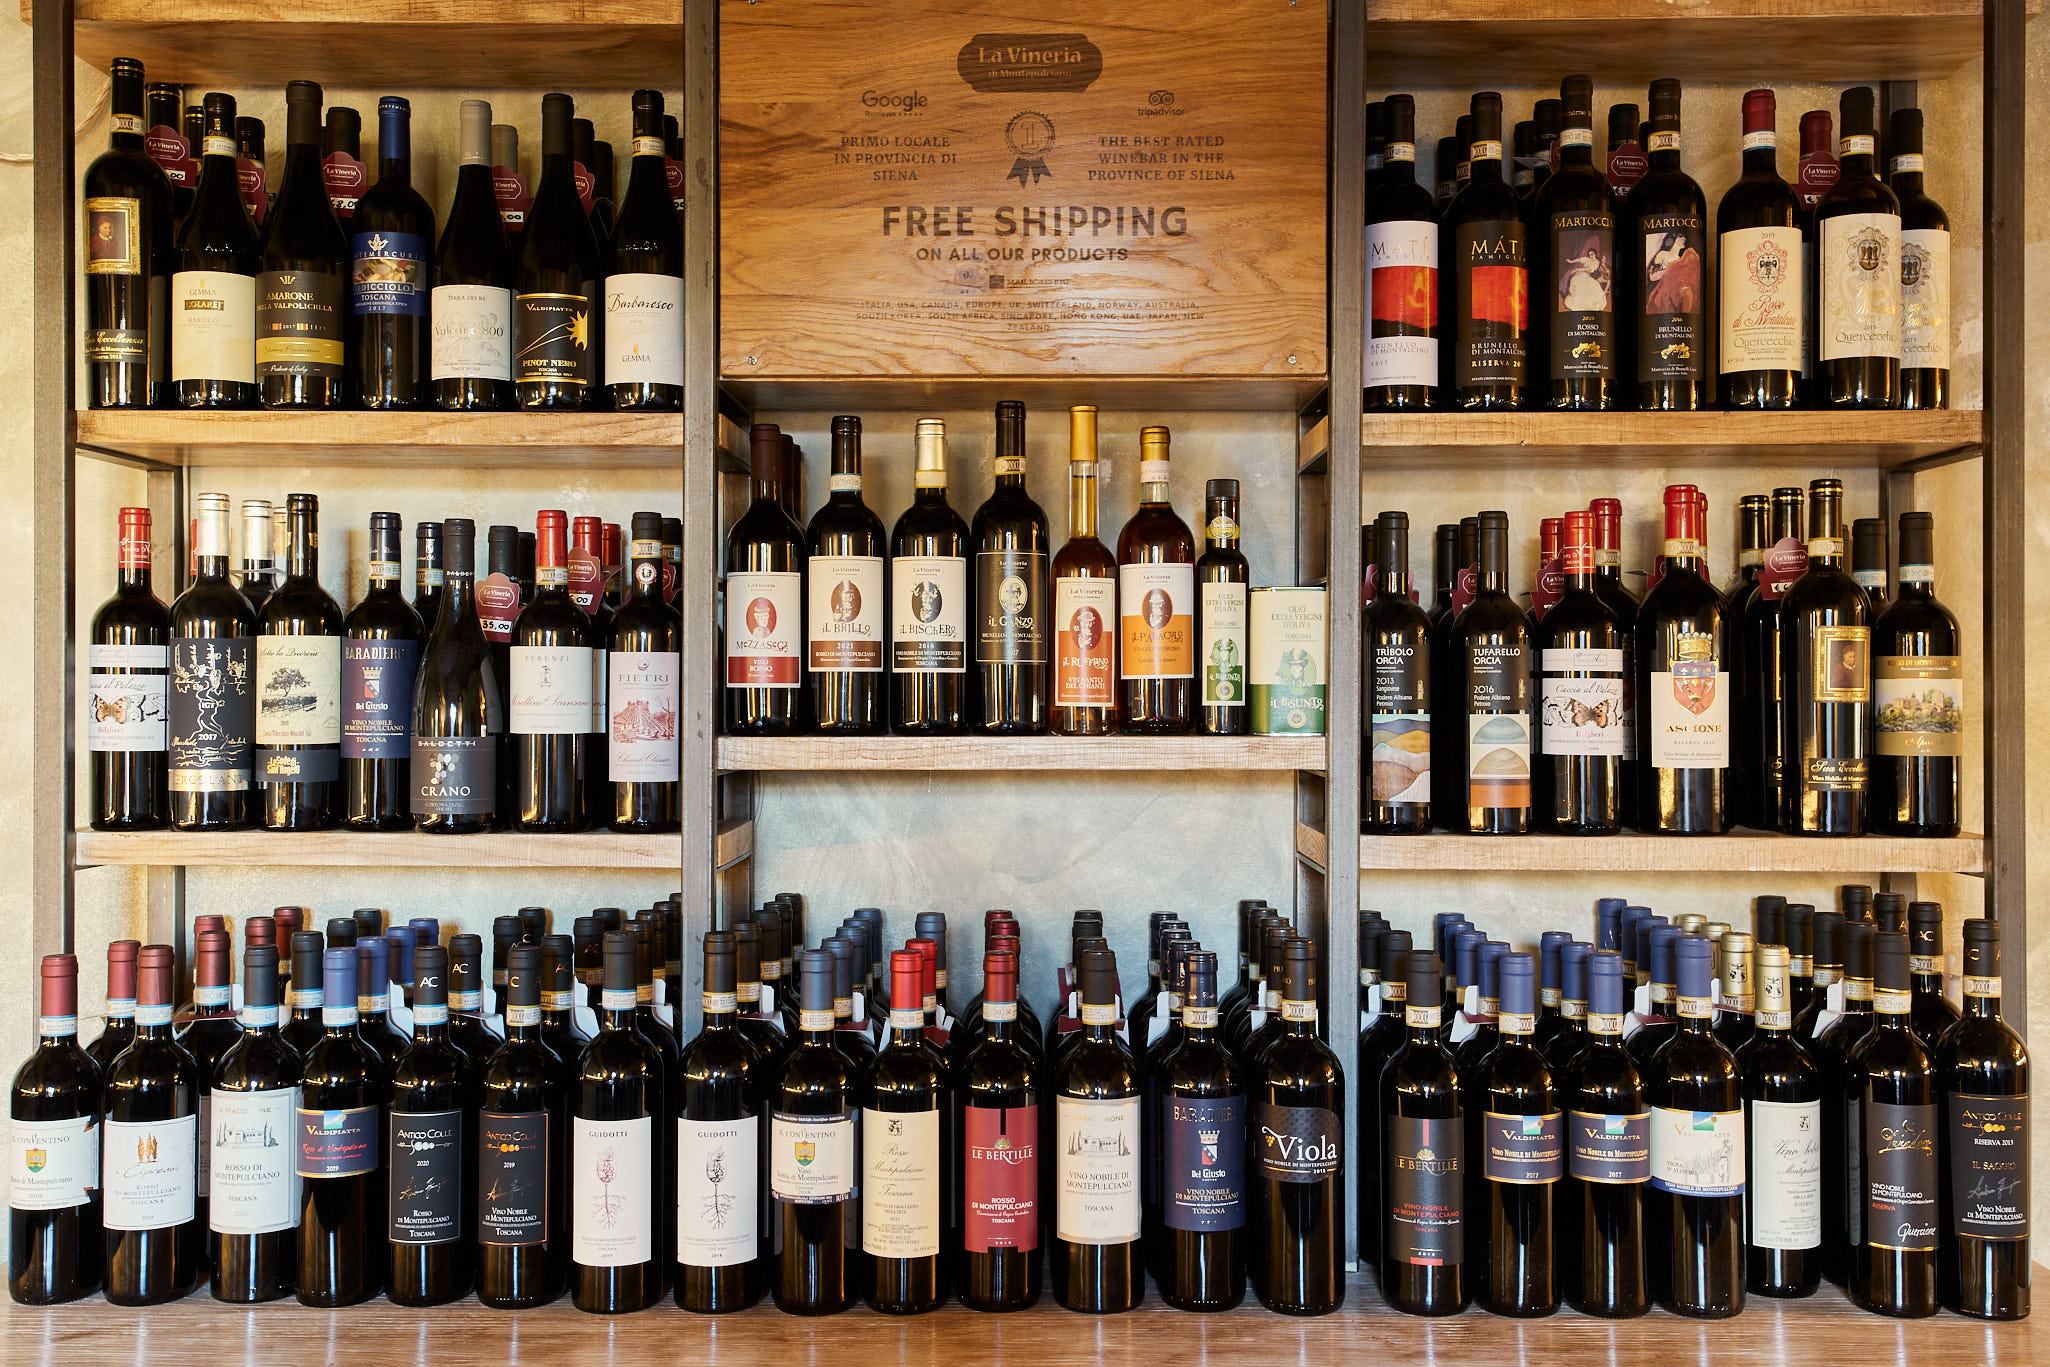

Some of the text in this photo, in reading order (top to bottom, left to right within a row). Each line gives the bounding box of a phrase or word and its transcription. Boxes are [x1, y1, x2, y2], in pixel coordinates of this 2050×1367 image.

[979, 47, 1081, 64] La Vineria
[989, 69, 998, 79] di
[861, 90, 928, 111] Google
[1137, 107, 1186, 117] tripadvisor
[841, 136, 951, 147] PRIMO LOCALE
[1099, 136, 1225, 147] THE BEST RATED
[834, 153, 957, 164] IN PROVINCIA DI
[1098, 153, 1225, 164] WINEBAR IN THE
[873, 170, 918, 181] SIENA
[1087, 170, 1236, 181] PROVINCE OF SIENA
[883, 206, 1188, 237] FREE SHIPPING
[915, 248, 1129, 260] ON ALL OUR PRODUCTS
[266, 291, 314, 301] AMARONE
[361, 293, 397, 301] TOSCANA
[607, 292, 674, 313] Barbaresco
[1748, 295, 1786, 314] Rosso
[525, 303, 574, 313] VALDIPIATTA
[1733, 335, 1795, 349] Quercecchio
[1835, 331, 1897, 344] Quercecchio
[522, 359, 549, 367] PINOT
[622, 354, 652, 363] GEMMA
[1471, 360, 1510, 368] RISERVA
[1376, 646, 1414, 657] TRÌBOLO
[1473, 648, 1521, 657] TUFARELLO
[1376, 656, 1404, 665] ORCIA
[1473, 656, 1502, 665] ORCIA
[618, 674, 670, 683] FIETRI
[1376, 677, 1395, 685] 2013
[1473, 685, 1495, 693] 2016
[355, 701, 389, 711] Del Giusto
[1666, 723, 1722, 733] ASCIONE
[421, 786, 471, 797] CRANO
[452, 963, 469, 974] AC
[419, 976, 439, 988] AC
[306, 1125, 362, 1136] VALDIPIATTA
[588, 1130, 629, 1138] GUIDOTTI
[697, 1130, 738, 1138] GUIDOTTI
[1501, 1129, 1556, 1141] VALDIPIATTA
[1585, 1128, 1641, 1141] VALDIPIATTA
[1264, 1128, 1338, 1162] Viola
[972, 1148, 1033, 1164] LE BERTILLE
[225, 1163, 262, 1171] ROSSO DI
[1395, 1158, 1458, 1176] LE BERTILLE
[215, 1171, 280, 1181] MONTEPULCIANO
[1069, 1171, 1129, 1181] VINO NOBILE DI
[1191, 1168, 1226, 1178] Del Giusto
[1066, 1180, 1132, 1191] MONTEPULCIANO
[1206, 1188, 1230, 1196] NOBILE
[1192, 1207, 1226, 1215] TOSCANA
[1403, 1203, 1449, 1212] VINO NOBILE
[1872, 1203, 1896, 1211] RISERVA
[413, 1209, 433, 1218] ROSSO
[409, 1229, 436, 1238] TOSCANA
[495, 1227, 523, 1236] TOSCANA
